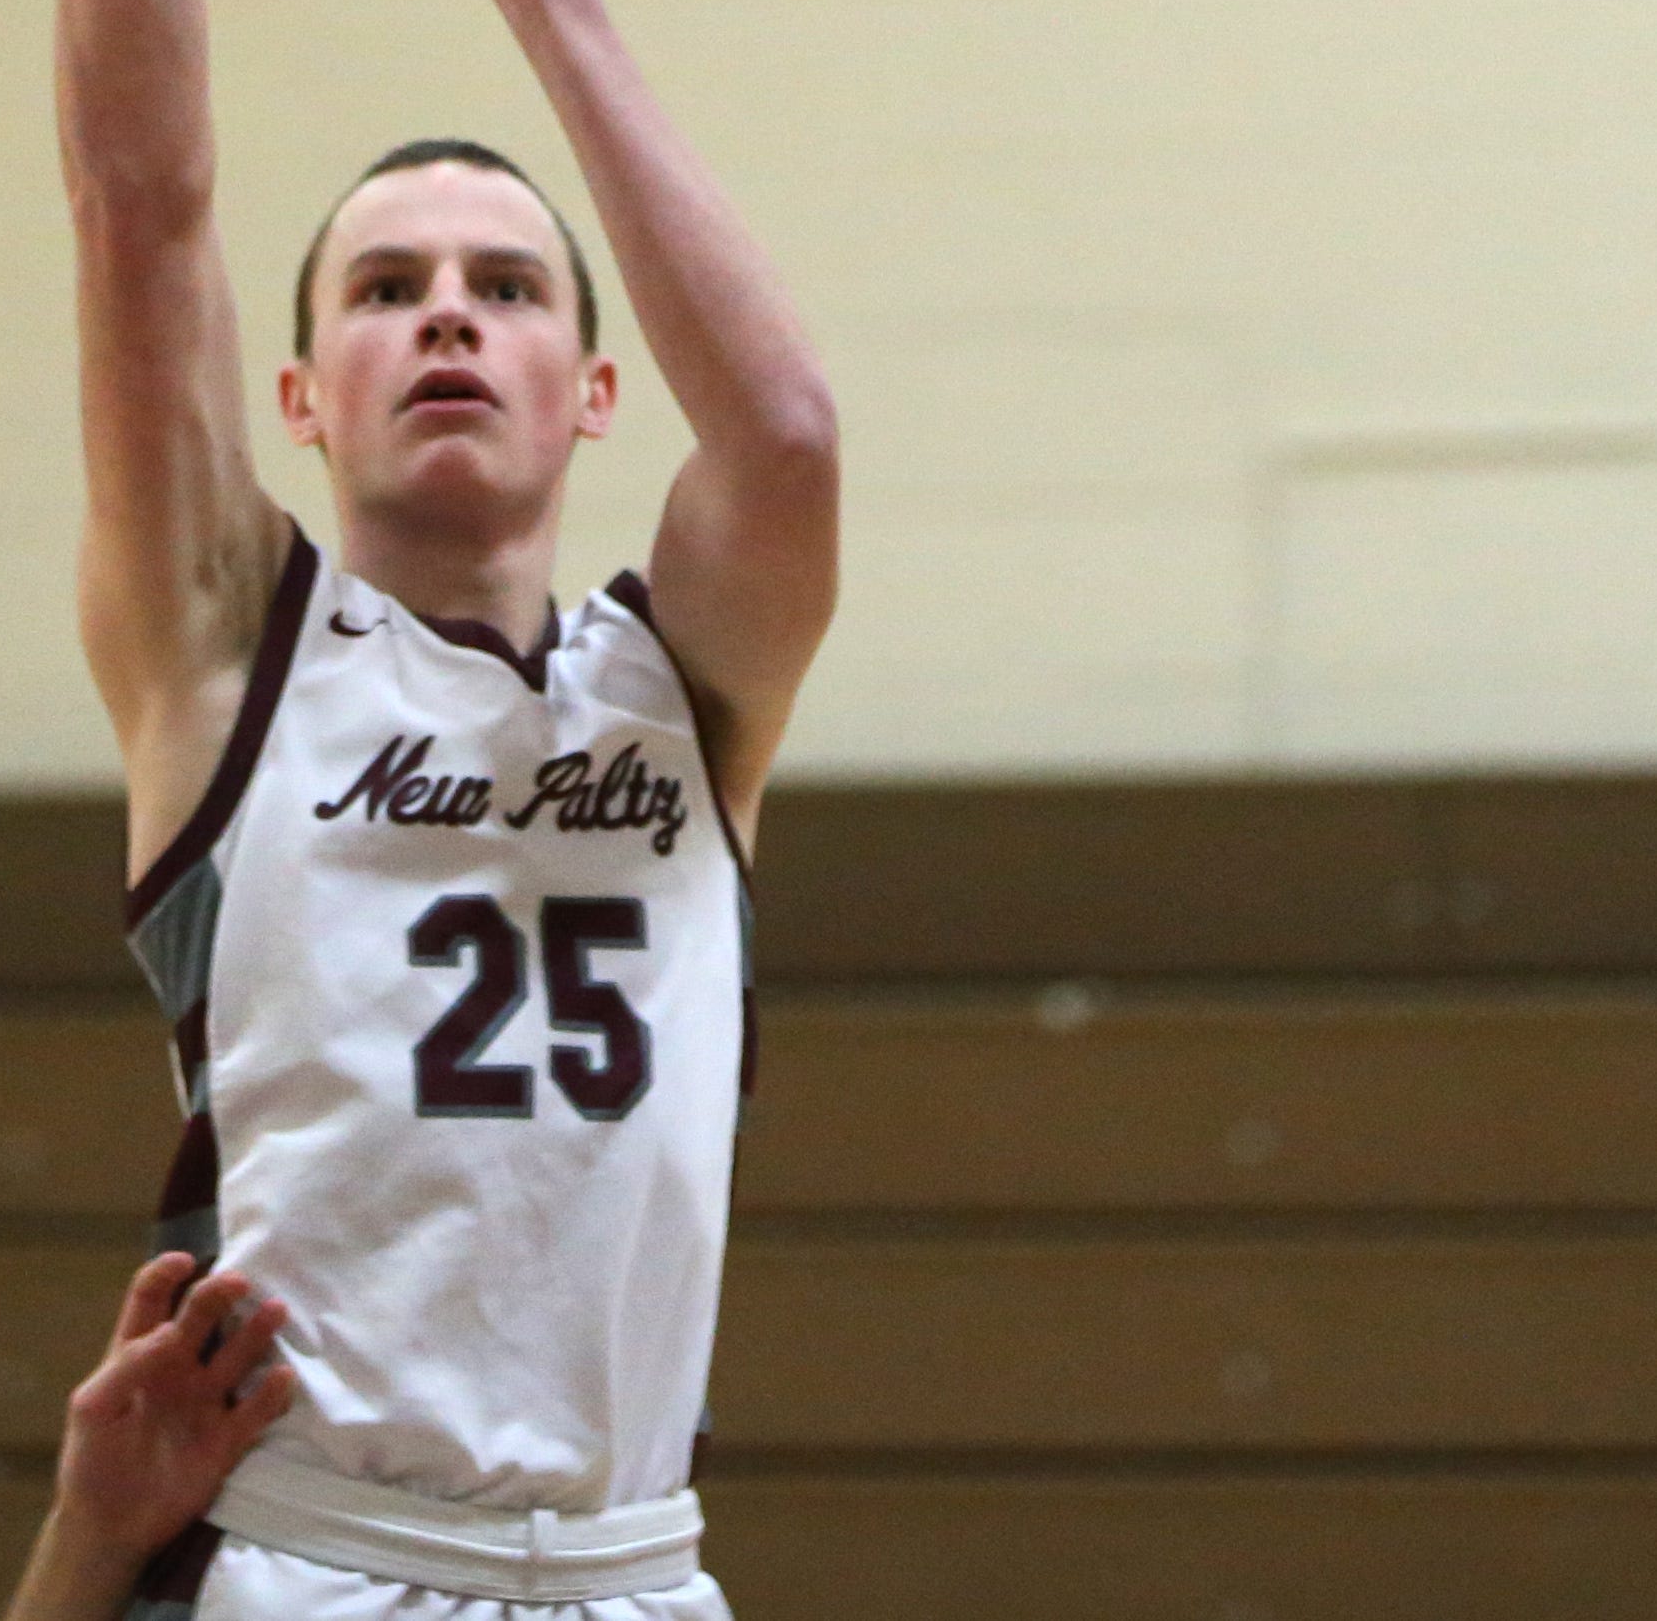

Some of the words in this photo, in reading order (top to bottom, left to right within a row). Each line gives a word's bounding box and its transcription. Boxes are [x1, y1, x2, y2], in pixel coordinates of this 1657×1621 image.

[314, 734, 493, 826] New
[503, 742, 687, 857] Paltz
[406, 893, 655, 1122] 25
